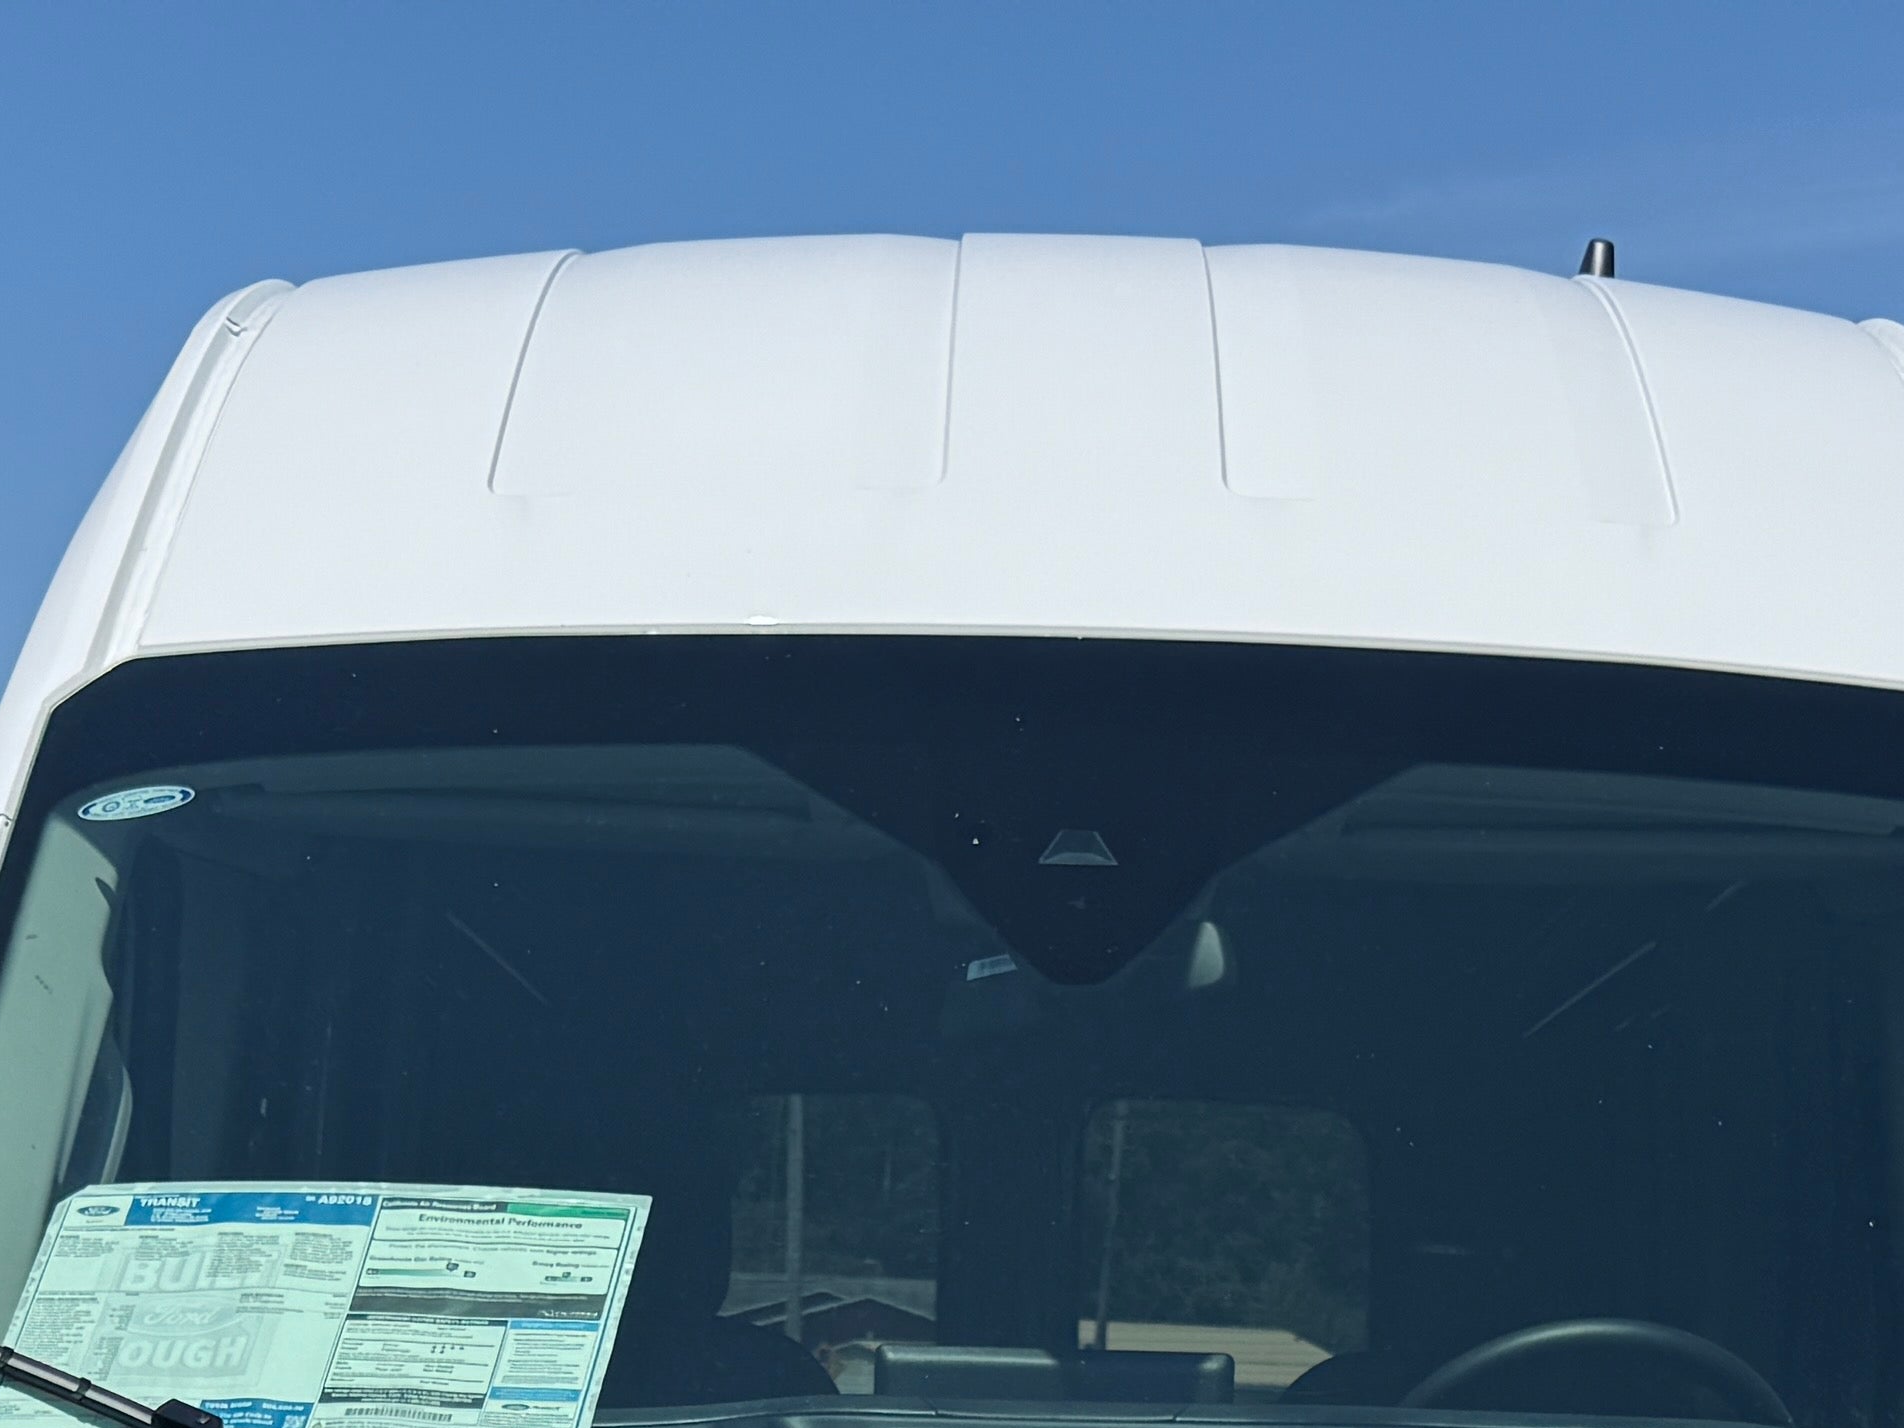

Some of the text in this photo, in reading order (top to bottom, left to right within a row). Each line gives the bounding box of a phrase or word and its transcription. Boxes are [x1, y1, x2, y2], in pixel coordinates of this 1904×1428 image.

[140, 1197, 200, 1207] TRANSIT
[418, 1213, 583, 1229] Environmental Performance
